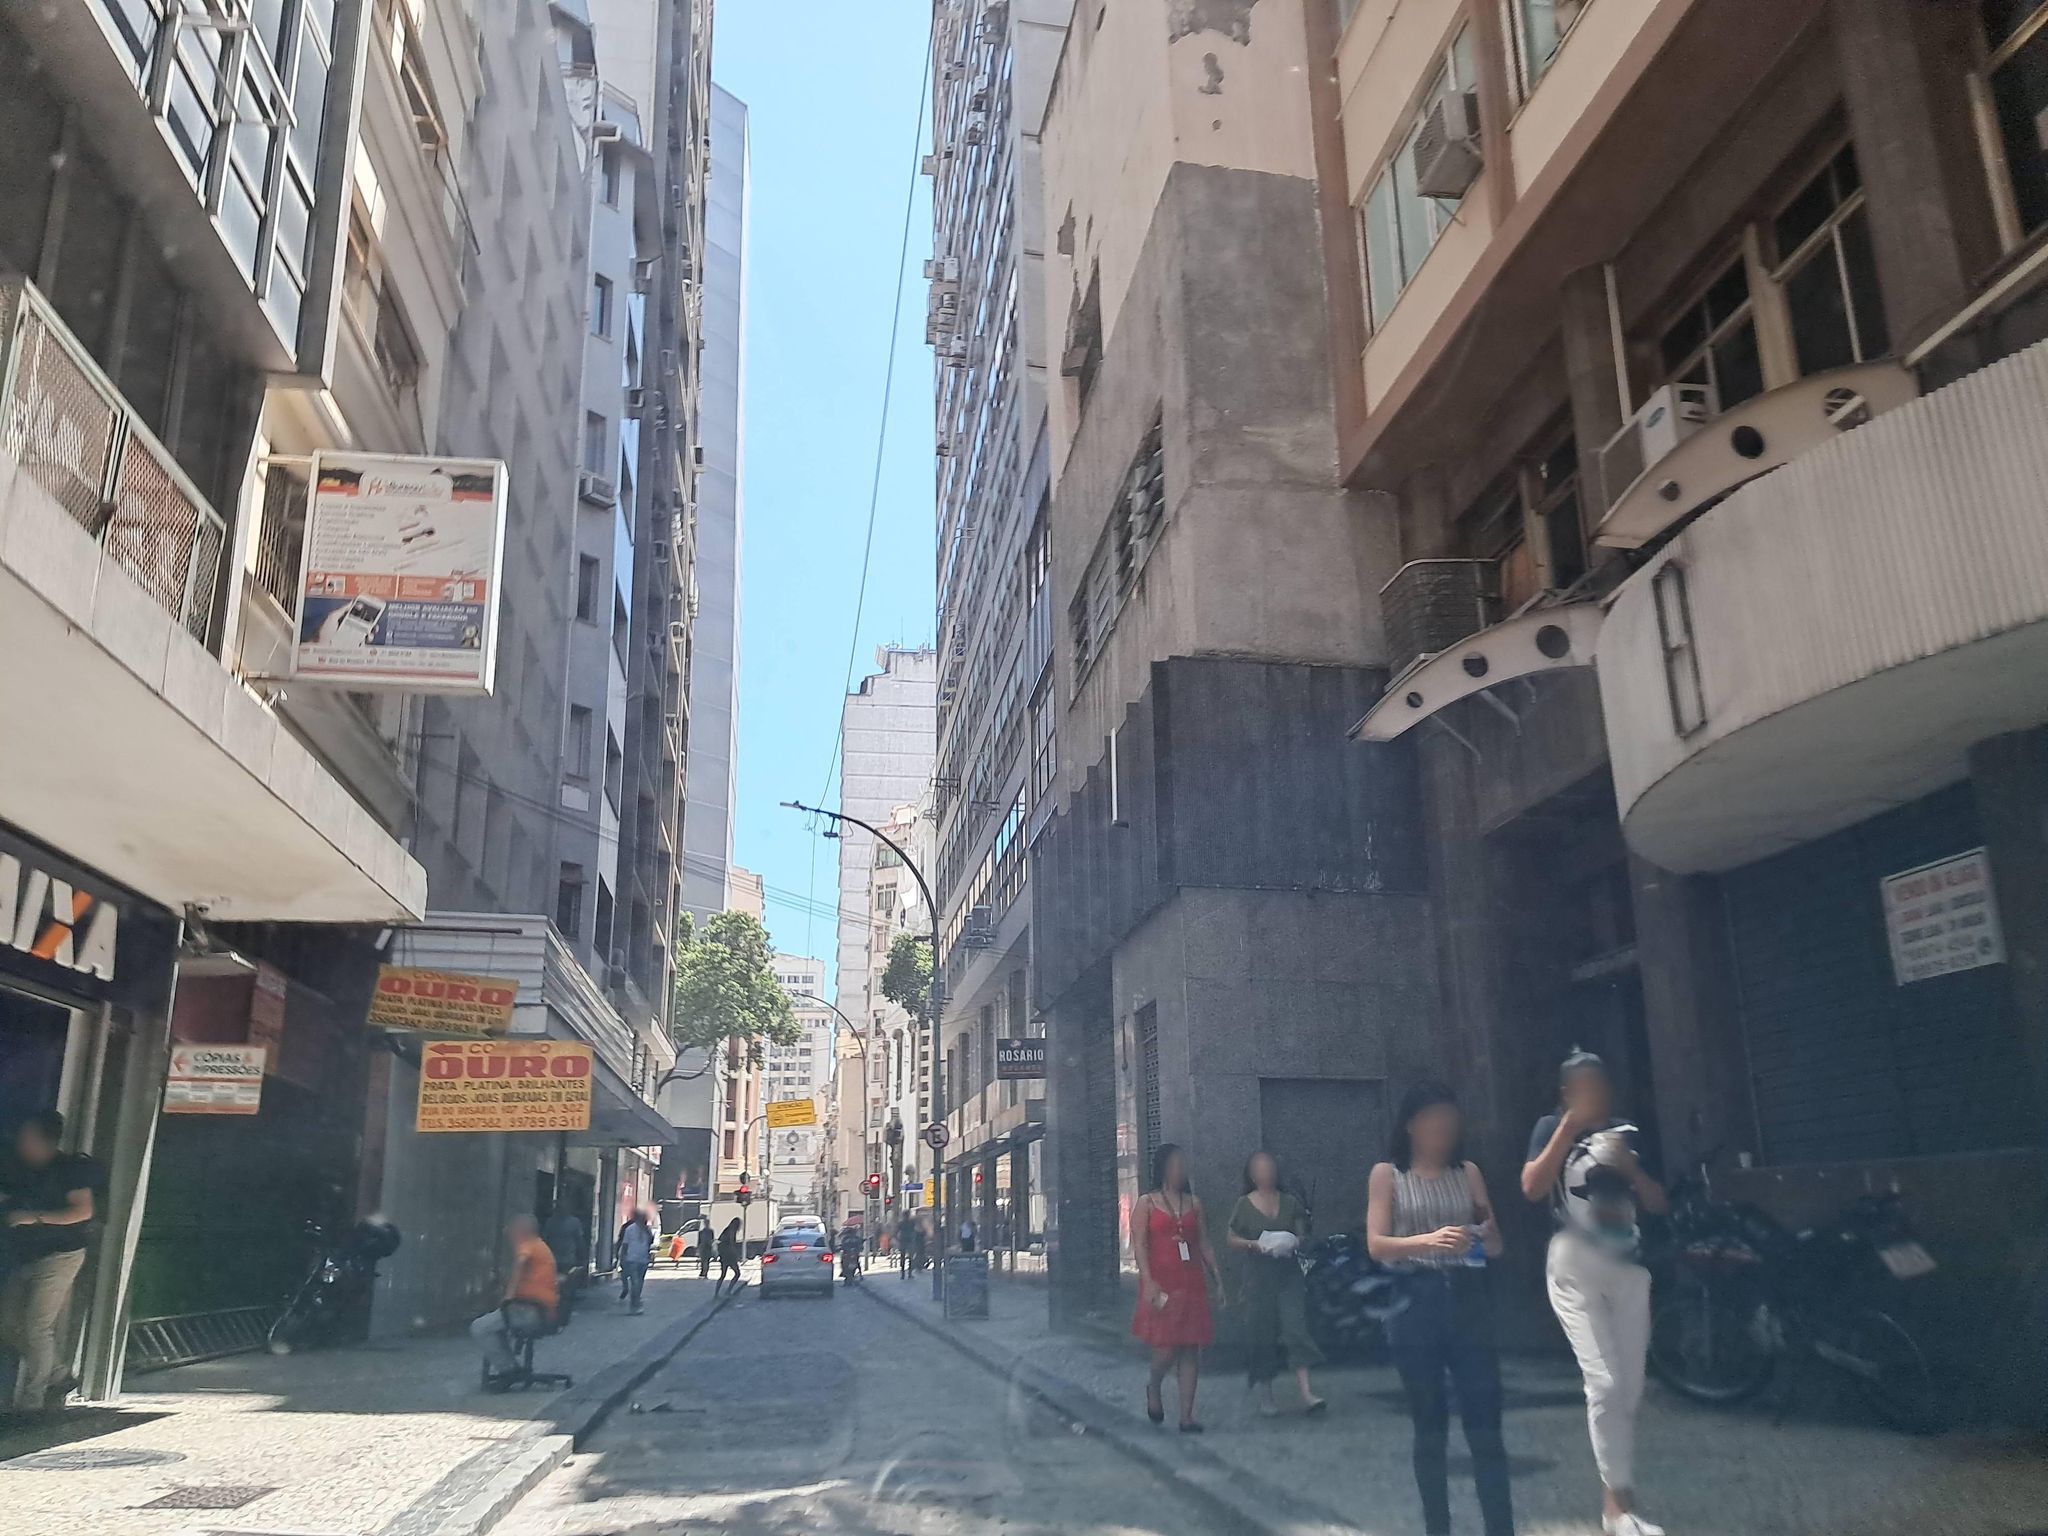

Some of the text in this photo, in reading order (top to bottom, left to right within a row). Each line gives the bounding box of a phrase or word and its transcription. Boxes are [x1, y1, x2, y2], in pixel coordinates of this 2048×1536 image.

[378, 977, 513, 1006] OURO
[469, 1043, 550, 1054] COO
[999, 1049, 1044, 1062] ROSARIO
[425, 1056, 590, 1079] OURO
[423, 1079, 585, 1091] PRATA PLATINA BRILHANTES
[523, 1103, 556, 1114] SALA
[561, 1103, 584, 1113] 302
